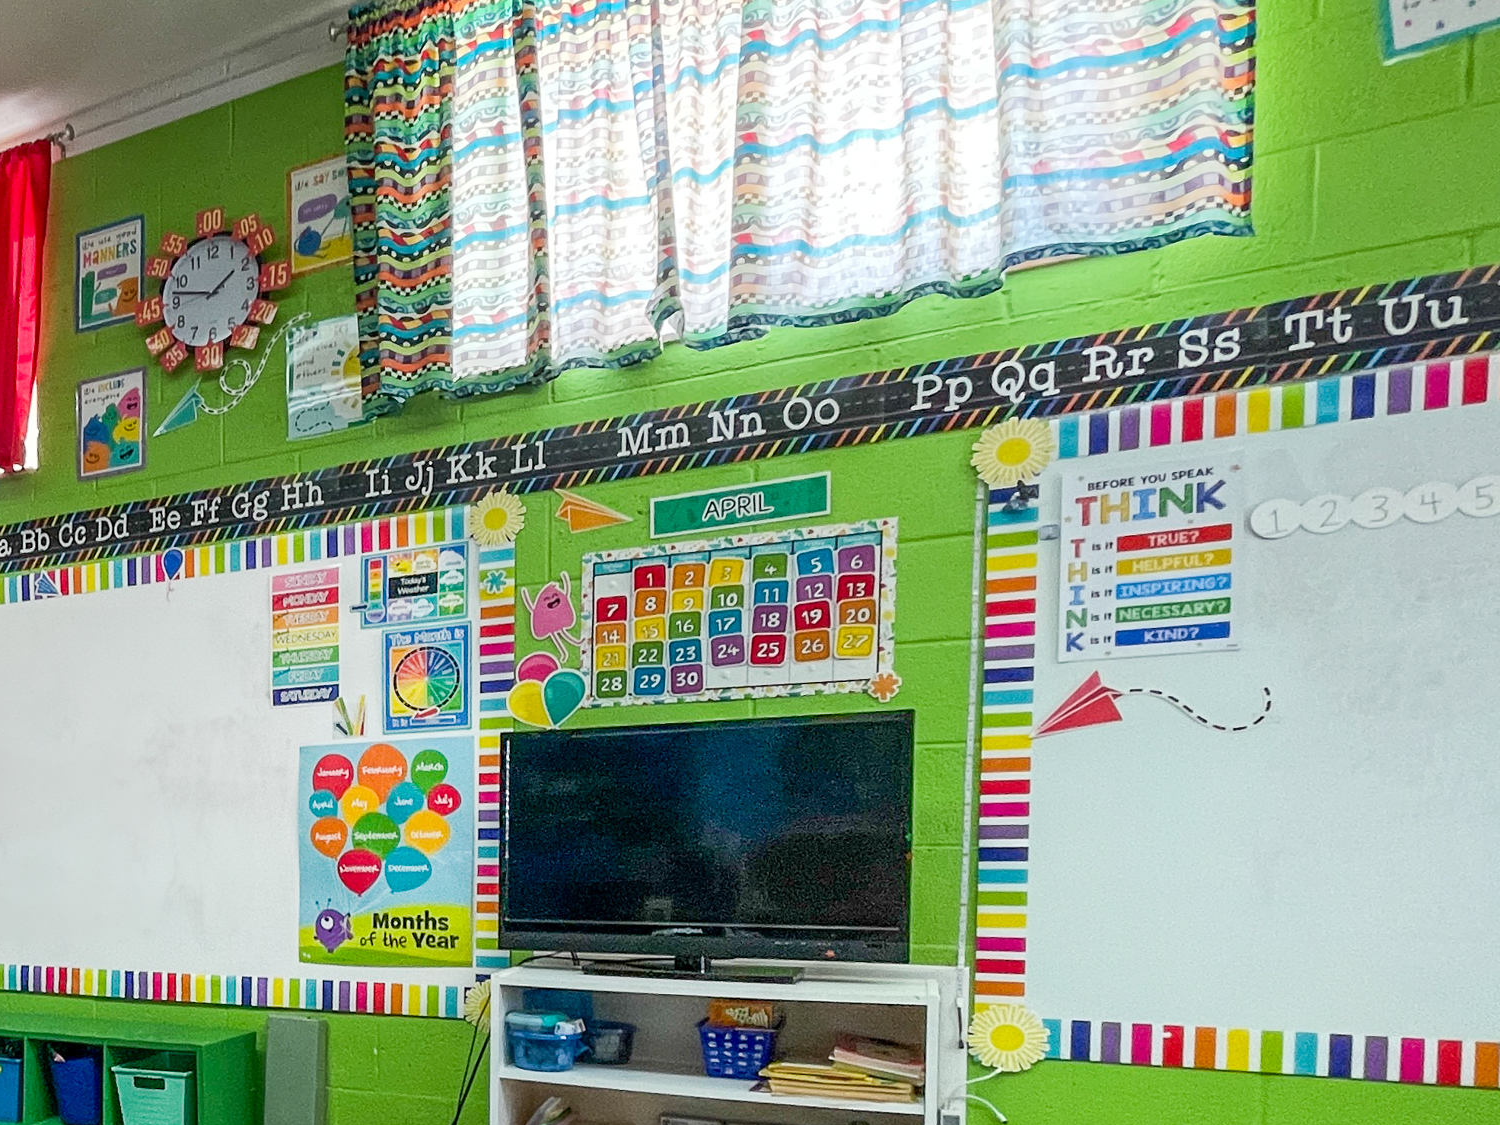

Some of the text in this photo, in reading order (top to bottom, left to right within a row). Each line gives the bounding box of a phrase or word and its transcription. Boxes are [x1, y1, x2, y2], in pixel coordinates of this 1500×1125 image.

[198, 208, 222, 234] :00
[237, 214, 258, 237] :05
[116, 224, 138, 242] good
[252, 228, 274, 253] :10
[164, 235, 186, 253] :55
[206, 246, 220, 260] 12
[146, 258, 169, 276] :50
[190, 256, 201, 271] 11
[175, 274, 188, 288] 10
[262, 262, 288, 288] :15
[246, 277, 256, 291] 3
[138, 297, 161, 324] :45
[172, 296, 181, 310] 9
[177, 315, 186, 329] 8
[97, 378, 125, 393] INCLUDE
[84, 391, 121, 406] everyone
[20, 527, 50, 554] Bb
[58, 520, 87, 549] Cc
[95, 513, 130, 542] Dd
[149, 506, 182, 533] Ee
[190, 497, 222, 527] Ff
[231, 488, 270, 522] Gg
[280, 481, 325, 512] Hh
[364, 468, 393, 498] Ii
[404, 460, 435, 497] Jj
[446, 451, 498, 485] Kk
[509, 441, 547, 475] Ll
[617, 422, 691, 458] Mm
[706, 407, 767, 444] Nn
[783, 396, 841, 431] Oo
[910, 373, 974, 412] Pp
[991, 359, 1060, 403] Qq
[1080, 345, 1155, 383] Rr
[1177, 325, 1244, 368] Ss
[1285, 305, 1353, 352] Tt
[1378, 294, 1470, 336] Uu
[1087, 466, 1214, 492] BEFORE YOU SPEAK
[703, 492, 773, 521] APRIL
[1075, 479, 1227, 526] THINK
[1265, 482, 1494, 536] 1 2 3 4 5
[1070, 530, 1200, 558] T is it TRUE?
[810, 557, 823, 573] 5
[1132, 553, 1215, 572] HELPFUL?
[284, 571, 327, 588] SUNDAY
[1120, 576, 1228, 597] INSPIRING?
[397, 584, 430, 595] Weather
[804, 583, 825, 598] 12
[282, 590, 329, 607] MONDAY
[1118, 601, 1228, 620] NECESSARY?
[715, 617, 736, 632] 17
[760, 612, 781, 628] 18
[275, 630, 337, 644] WEDNESDAY
[388, 633, 411, 646] The
[414, 629, 452, 644] Month
[1066, 627, 1200, 652] K KIND?
[757, 642, 780, 658] 25
[801, 639, 824, 654] 26
[288, 667, 325, 683] FRIDAY
[676, 672, 698, 687] 30
[280, 686, 332, 702] SATURDAY
[312, 799, 334, 810] April
[351, 798, 368, 811] May
[393, 796, 414, 806] June
[434, 794, 453, 807] July
[315, 832, 342, 845] August
[372, 910, 449, 931] Months
[359, 930, 460, 949] of the Year
